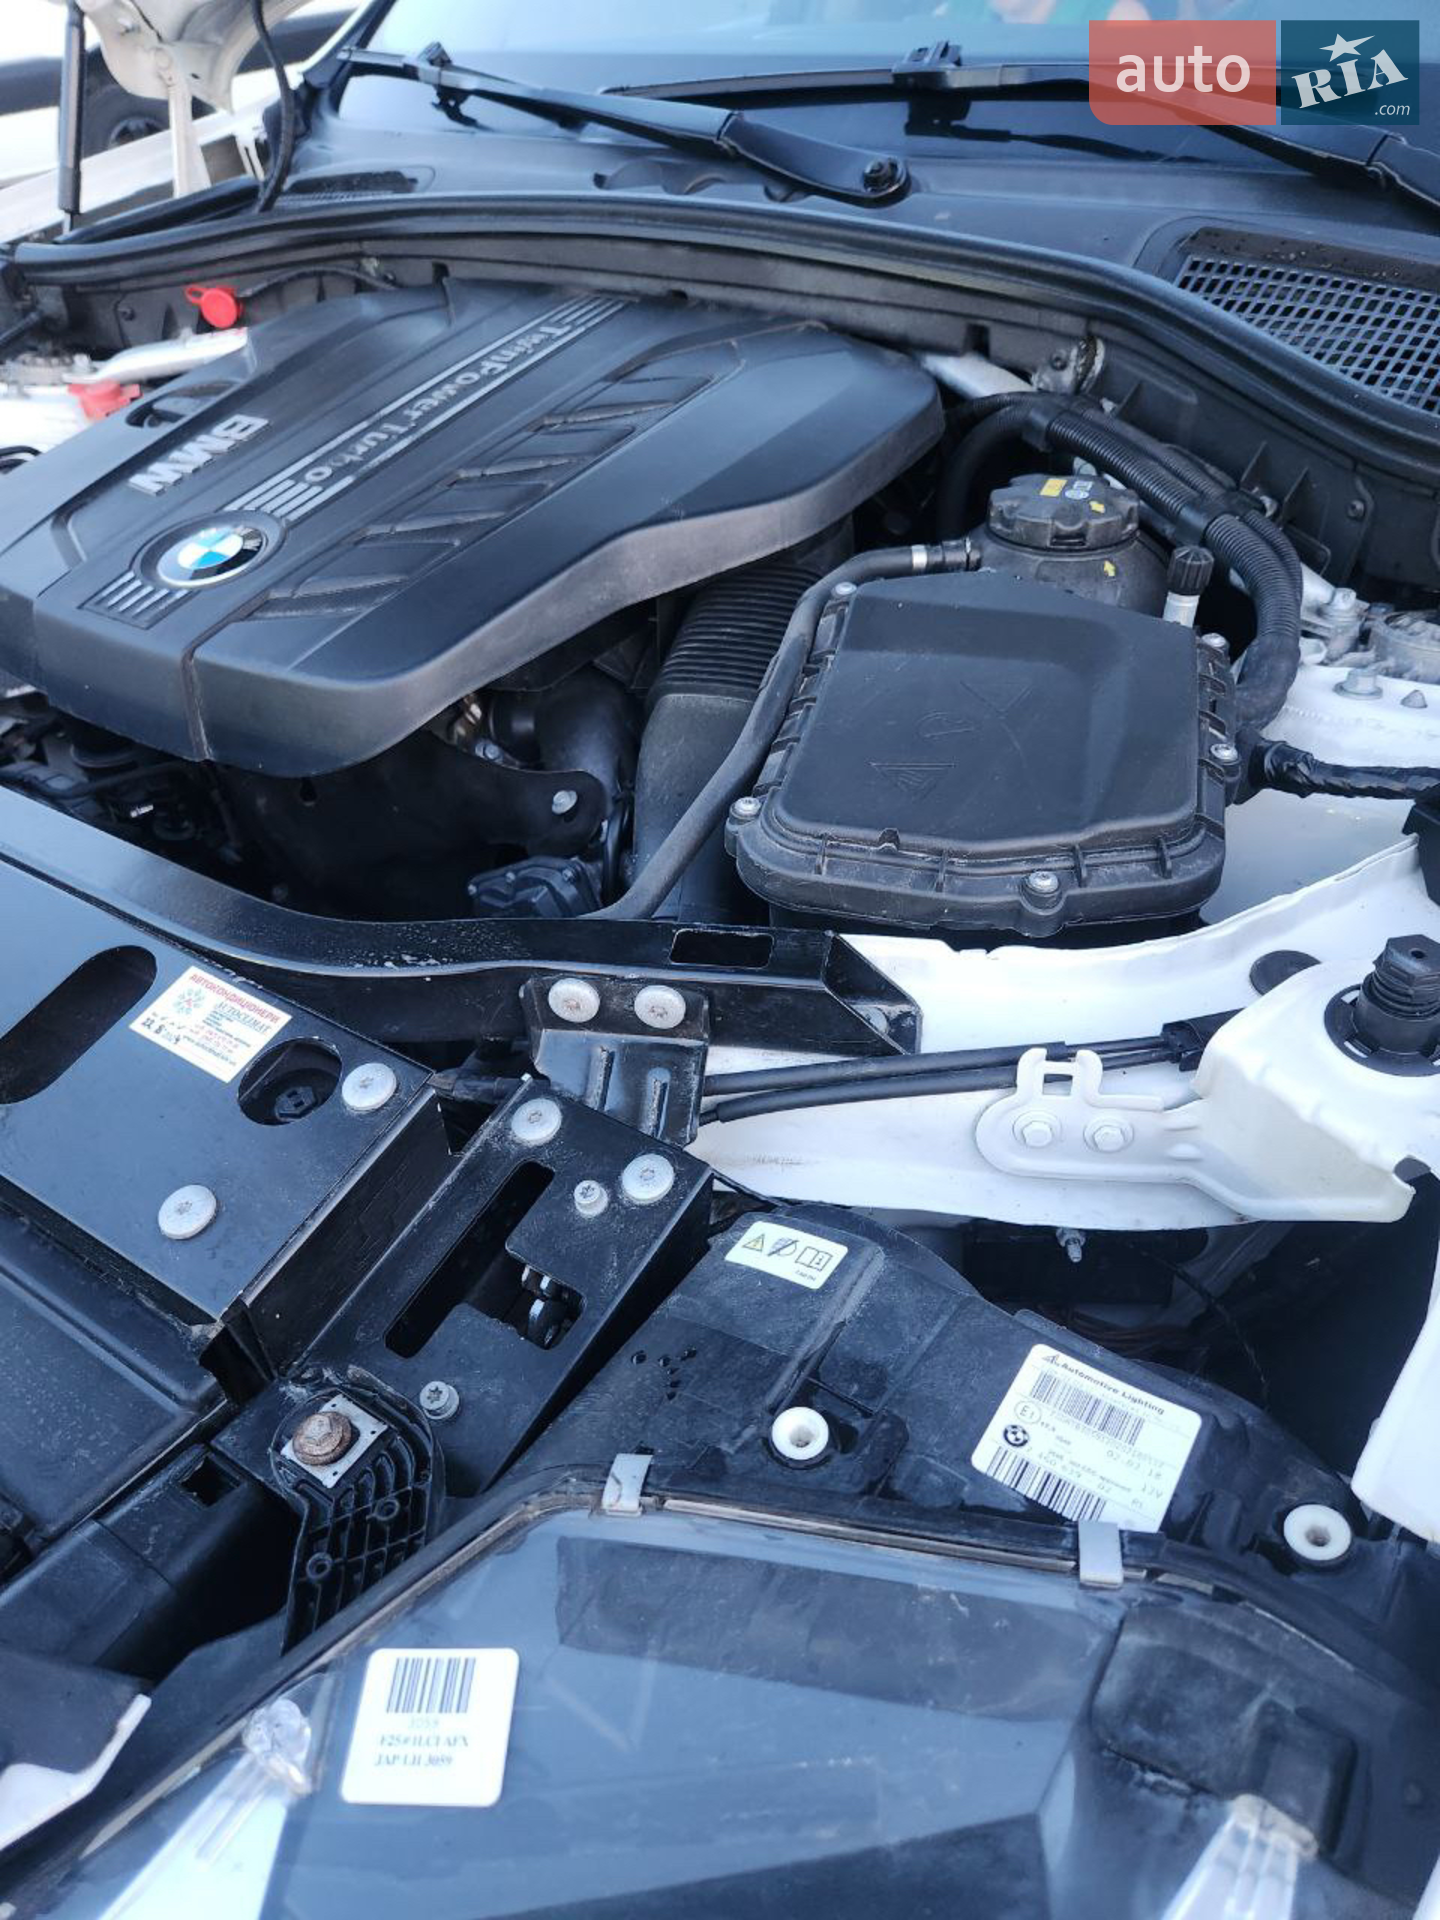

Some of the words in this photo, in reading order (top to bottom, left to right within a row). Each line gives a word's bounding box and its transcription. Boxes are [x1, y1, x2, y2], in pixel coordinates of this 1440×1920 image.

[129, 414, 270, 497] BMW
[1061, 1362, 1119, 1396] Automotive
[1121, 1391, 1166, 1416] Lighting
